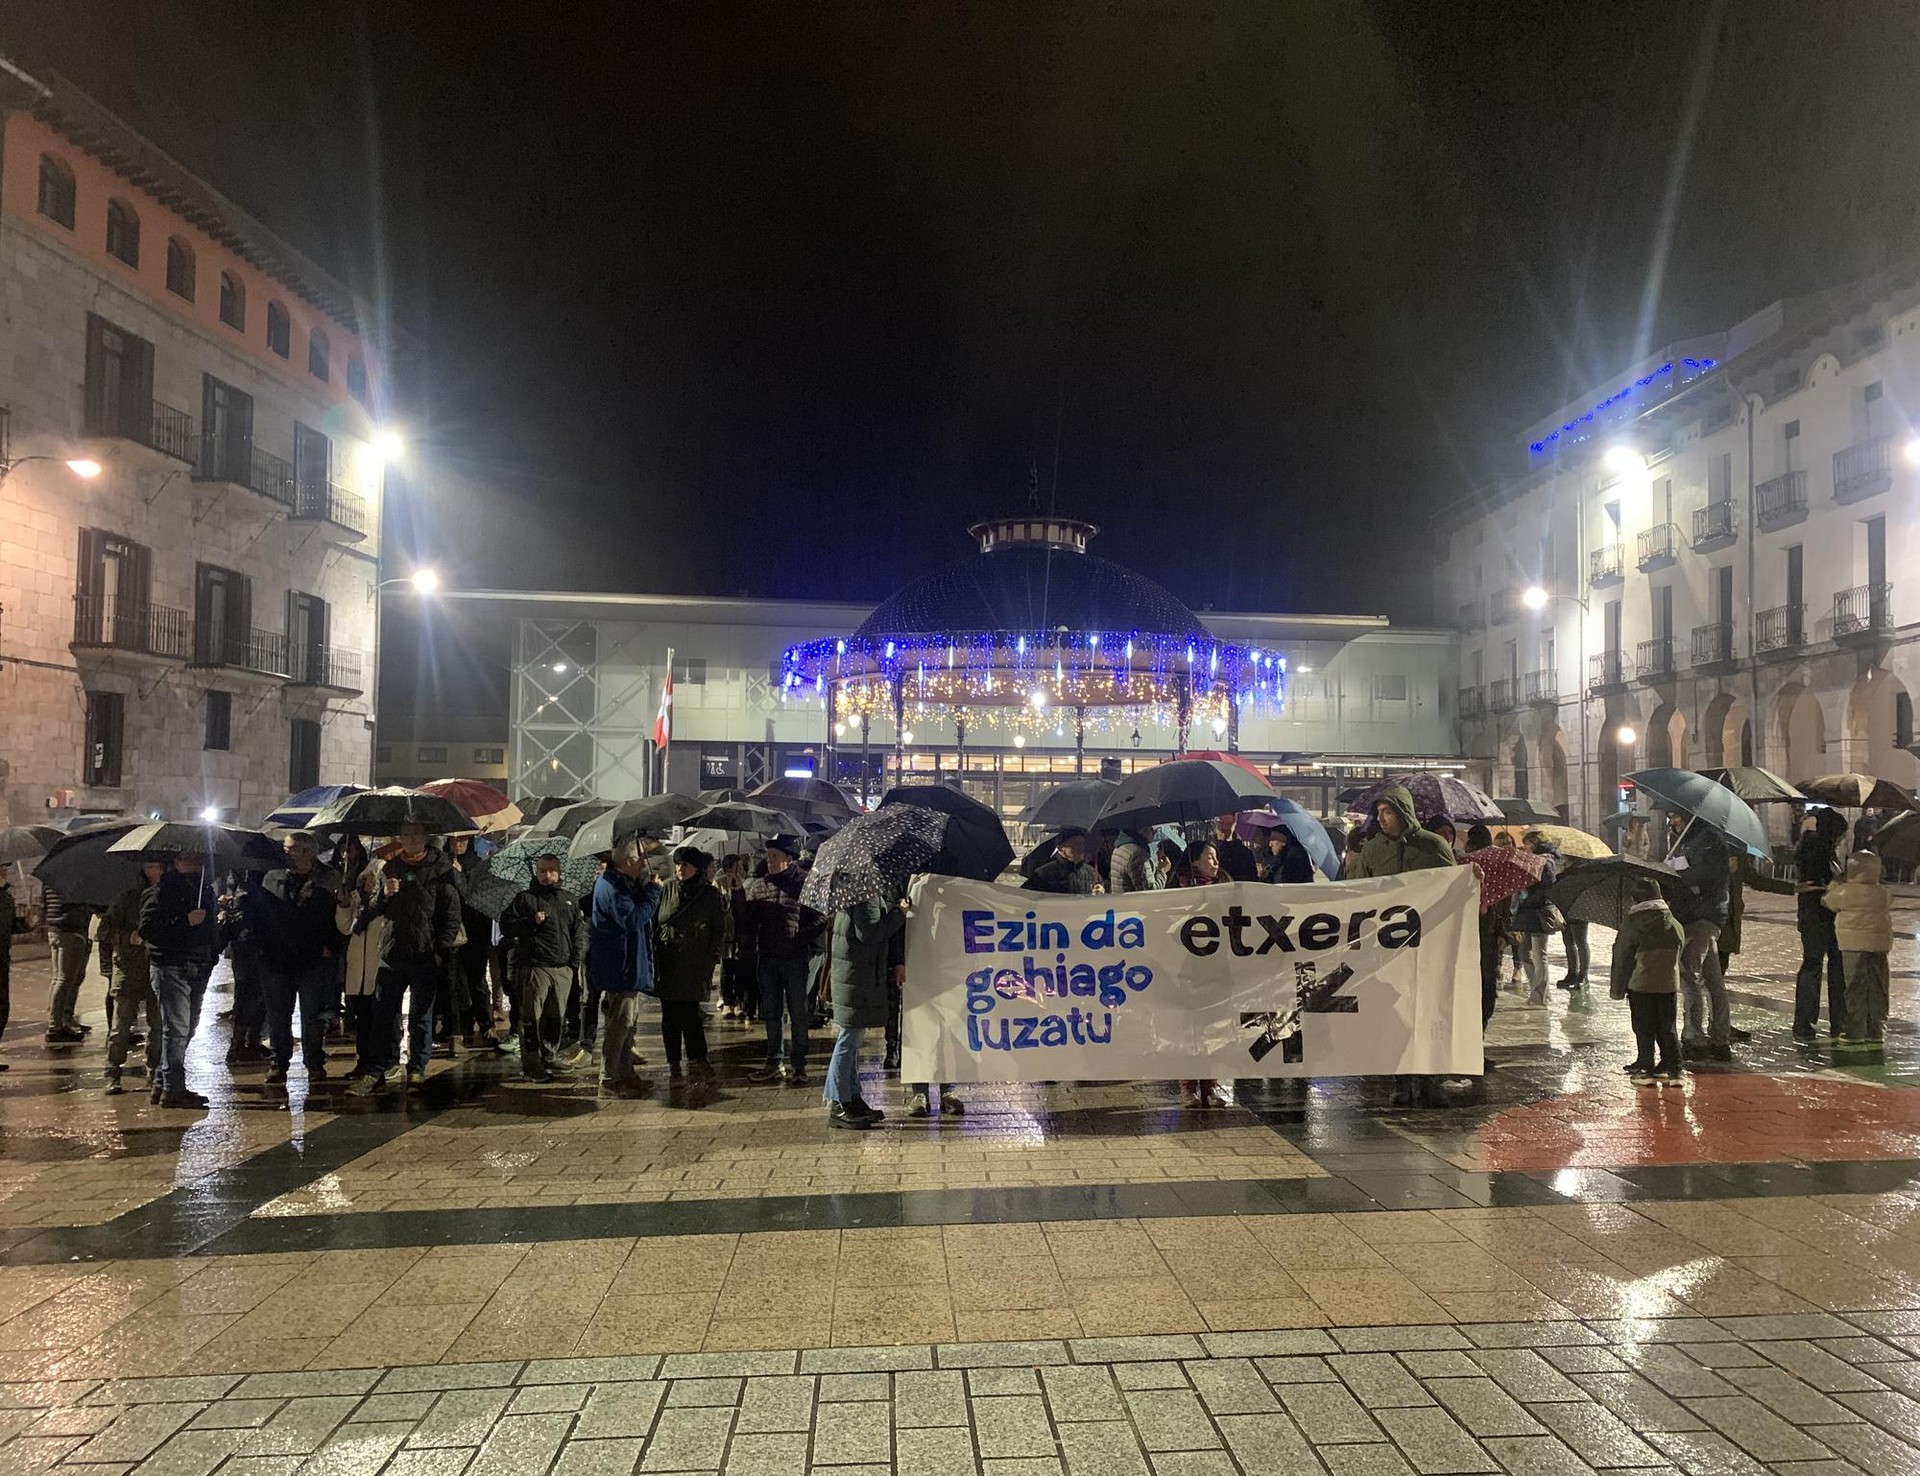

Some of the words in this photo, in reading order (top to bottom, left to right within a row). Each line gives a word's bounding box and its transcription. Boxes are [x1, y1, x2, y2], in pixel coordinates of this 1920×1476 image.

[962, 910, 1069, 954] Ezin
[1080, 909, 1145, 949] da
[1180, 904, 1422, 956] etxera
[965, 953, 1153, 1014] gehiago
[967, 1007, 1112, 1051] luzatu
